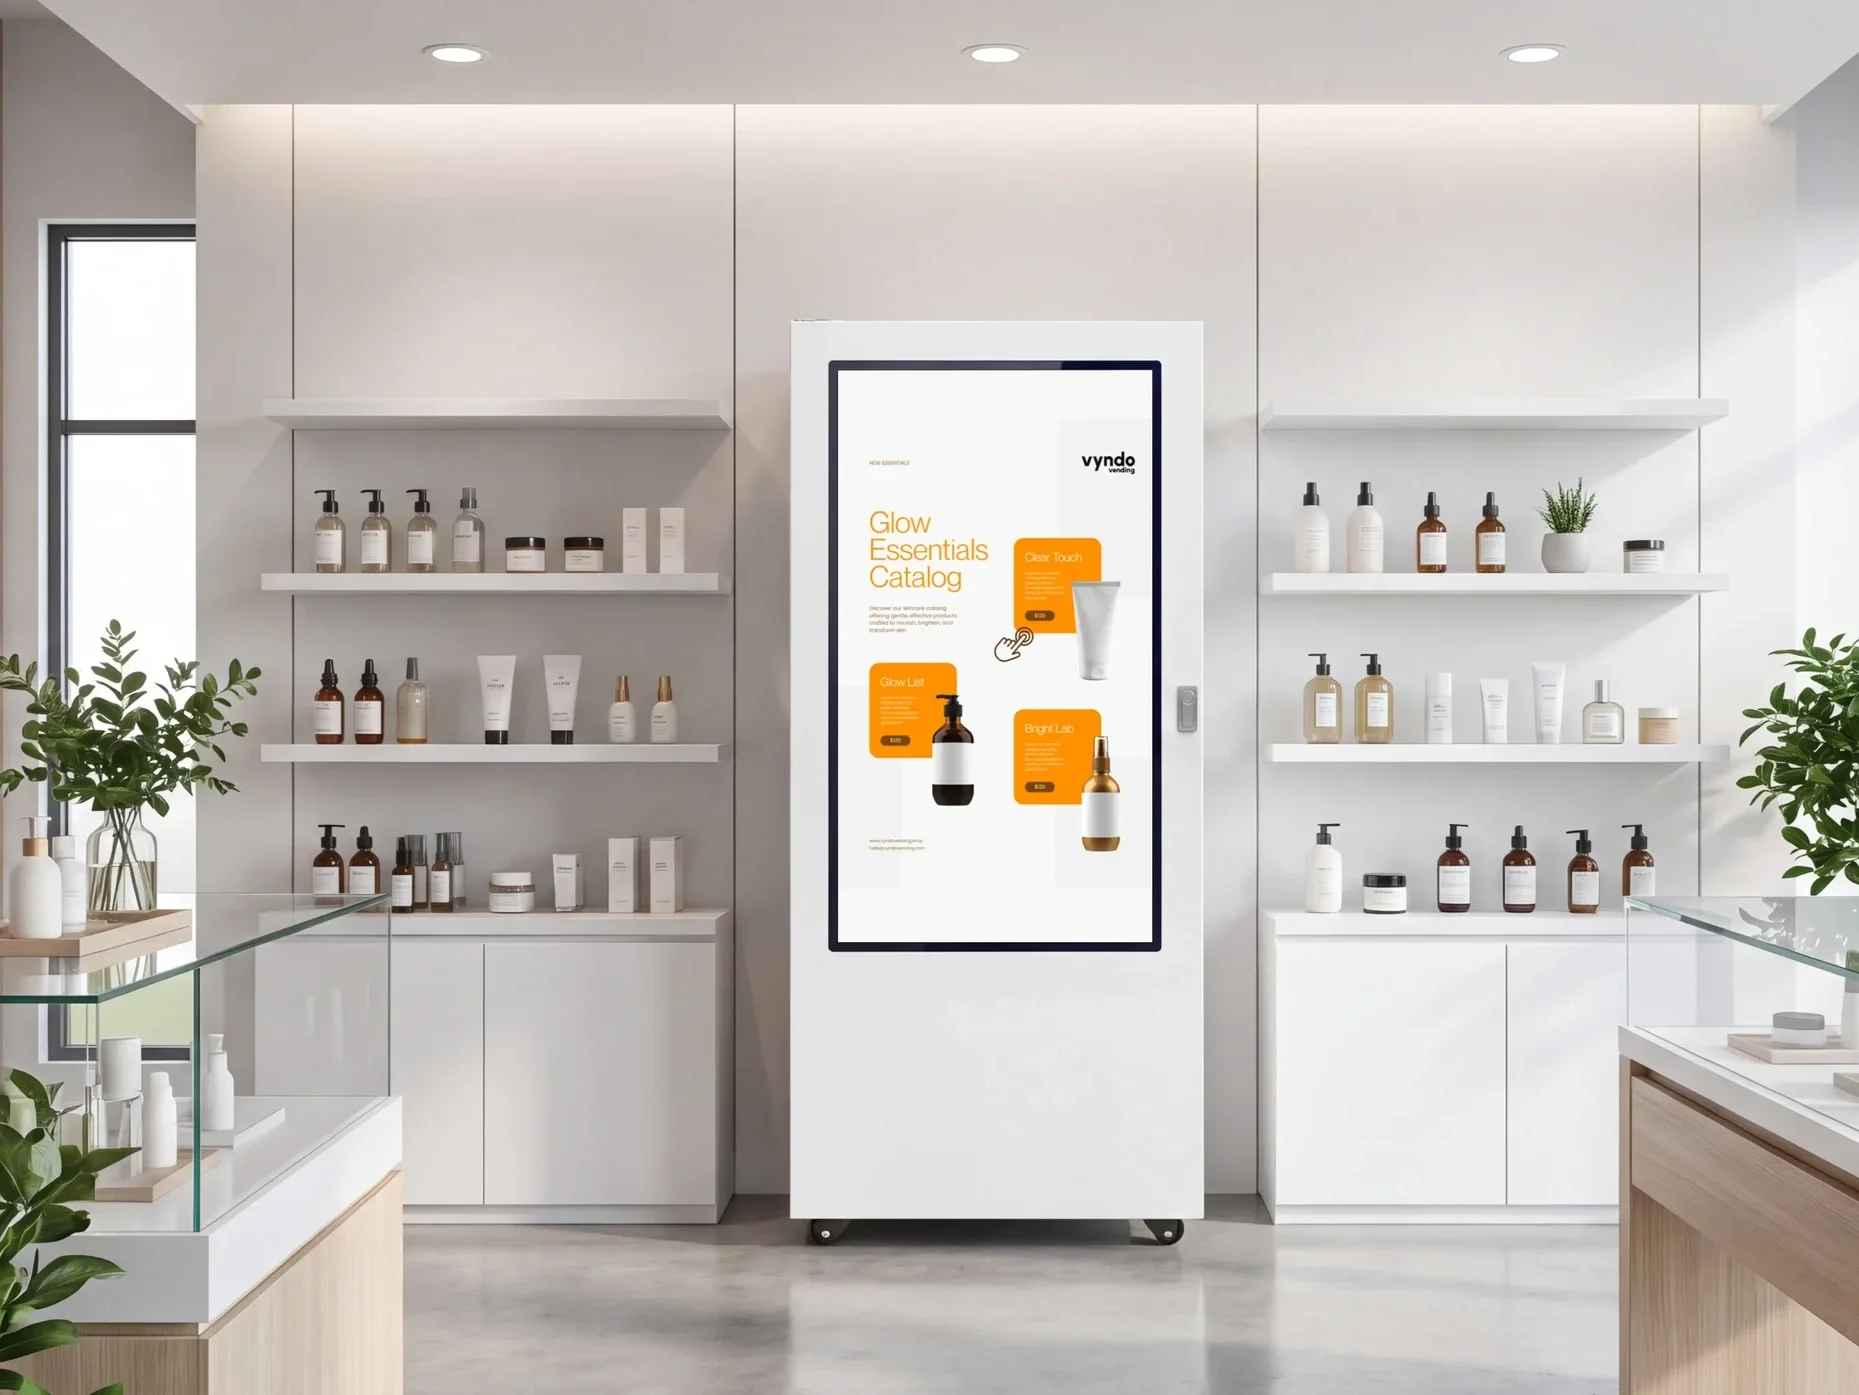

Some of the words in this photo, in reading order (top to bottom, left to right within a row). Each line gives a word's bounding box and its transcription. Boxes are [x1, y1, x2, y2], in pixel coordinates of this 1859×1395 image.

[1081, 451, 1136, 472] vyndo
[1108, 466, 1136, 475] vending
[870, 510, 932, 534] Glow
[870, 538, 989, 560] Essentials
[1024, 552, 1050, 562] Clear
[1053, 552, 1082, 562] Touch
[870, 565, 962, 592] Catalog
[880, 676, 906, 687] Glow
[907, 677, 924, 687] List
[1024, 723, 1053, 735] Bright
[1055, 723, 1074, 734] Lab
